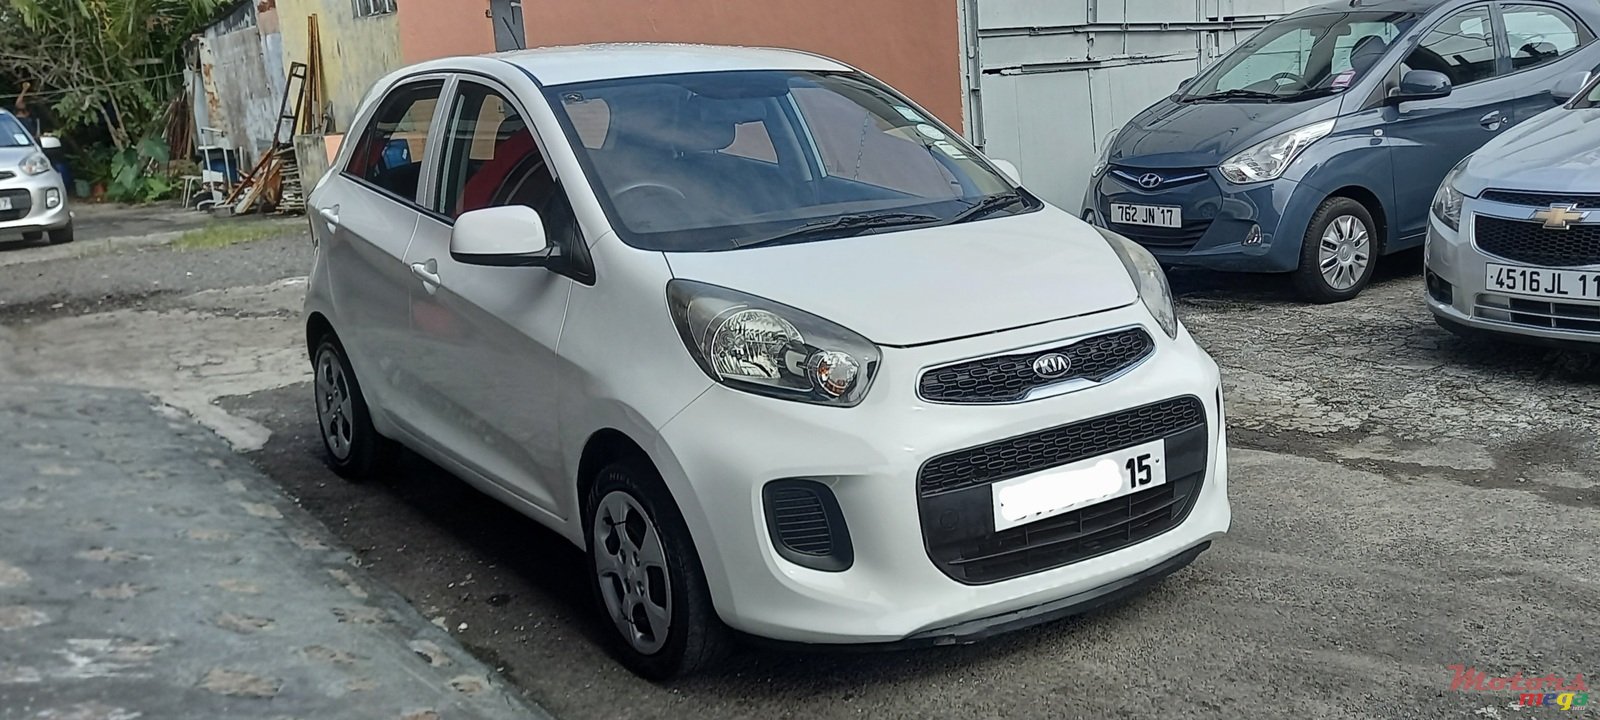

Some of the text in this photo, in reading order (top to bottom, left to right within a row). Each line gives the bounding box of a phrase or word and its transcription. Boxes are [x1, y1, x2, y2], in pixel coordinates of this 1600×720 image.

[1118, 206, 1173, 226] 762 JN 17
[1495, 267, 1600, 297] 4516 JL 11
[1039, 356, 1068, 374] KIA
[1125, 453, 1152, 489] 15
